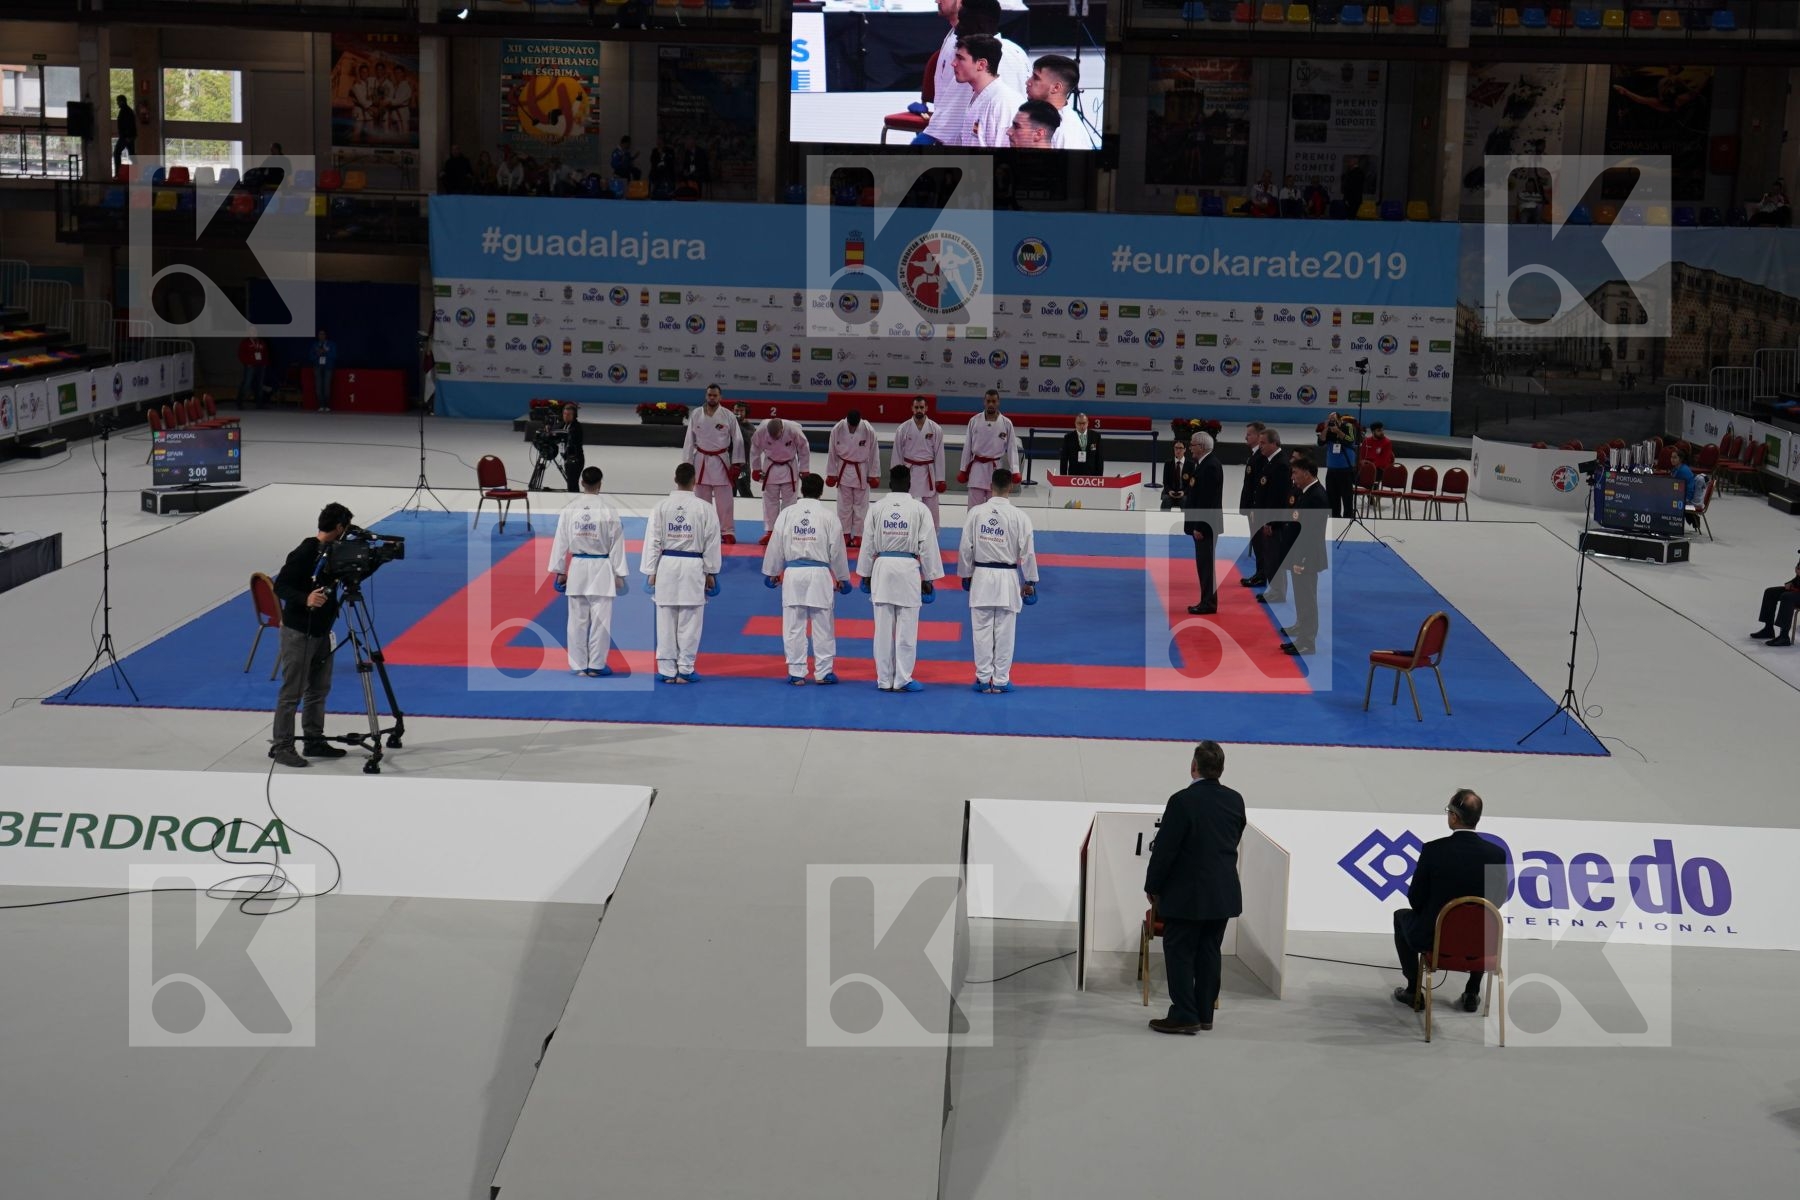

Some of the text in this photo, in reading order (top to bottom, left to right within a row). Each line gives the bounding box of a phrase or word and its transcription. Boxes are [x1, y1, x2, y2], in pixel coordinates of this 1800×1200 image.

[508, 44, 595, 55] XII CAMPEONATO
[504, 56, 599, 66] del MEDITERRANEO
[536, 68, 580, 77] ESGRIMA
[1336, 99, 1378, 108] PREMIO
[1336, 118, 1377, 127] DEPORTE
[1295, 152, 1337, 161] PREMIO
[482, 226, 706, 266] #guadalajara
[1022, 252, 1041, 261] WKF
[1112, 245, 1407, 280] #eurokarate2019
[770, 407, 777, 416] 2
[878, 404, 885, 414] 1
[1094, 419, 1101, 429] 3
[1071, 478, 1104, 487] COACH
[1617, 475, 1644, 484] PORTUGAL
[0, 811, 291, 854] BERDROLA
[1503, 916, 1738, 934] TERNATIONAL
